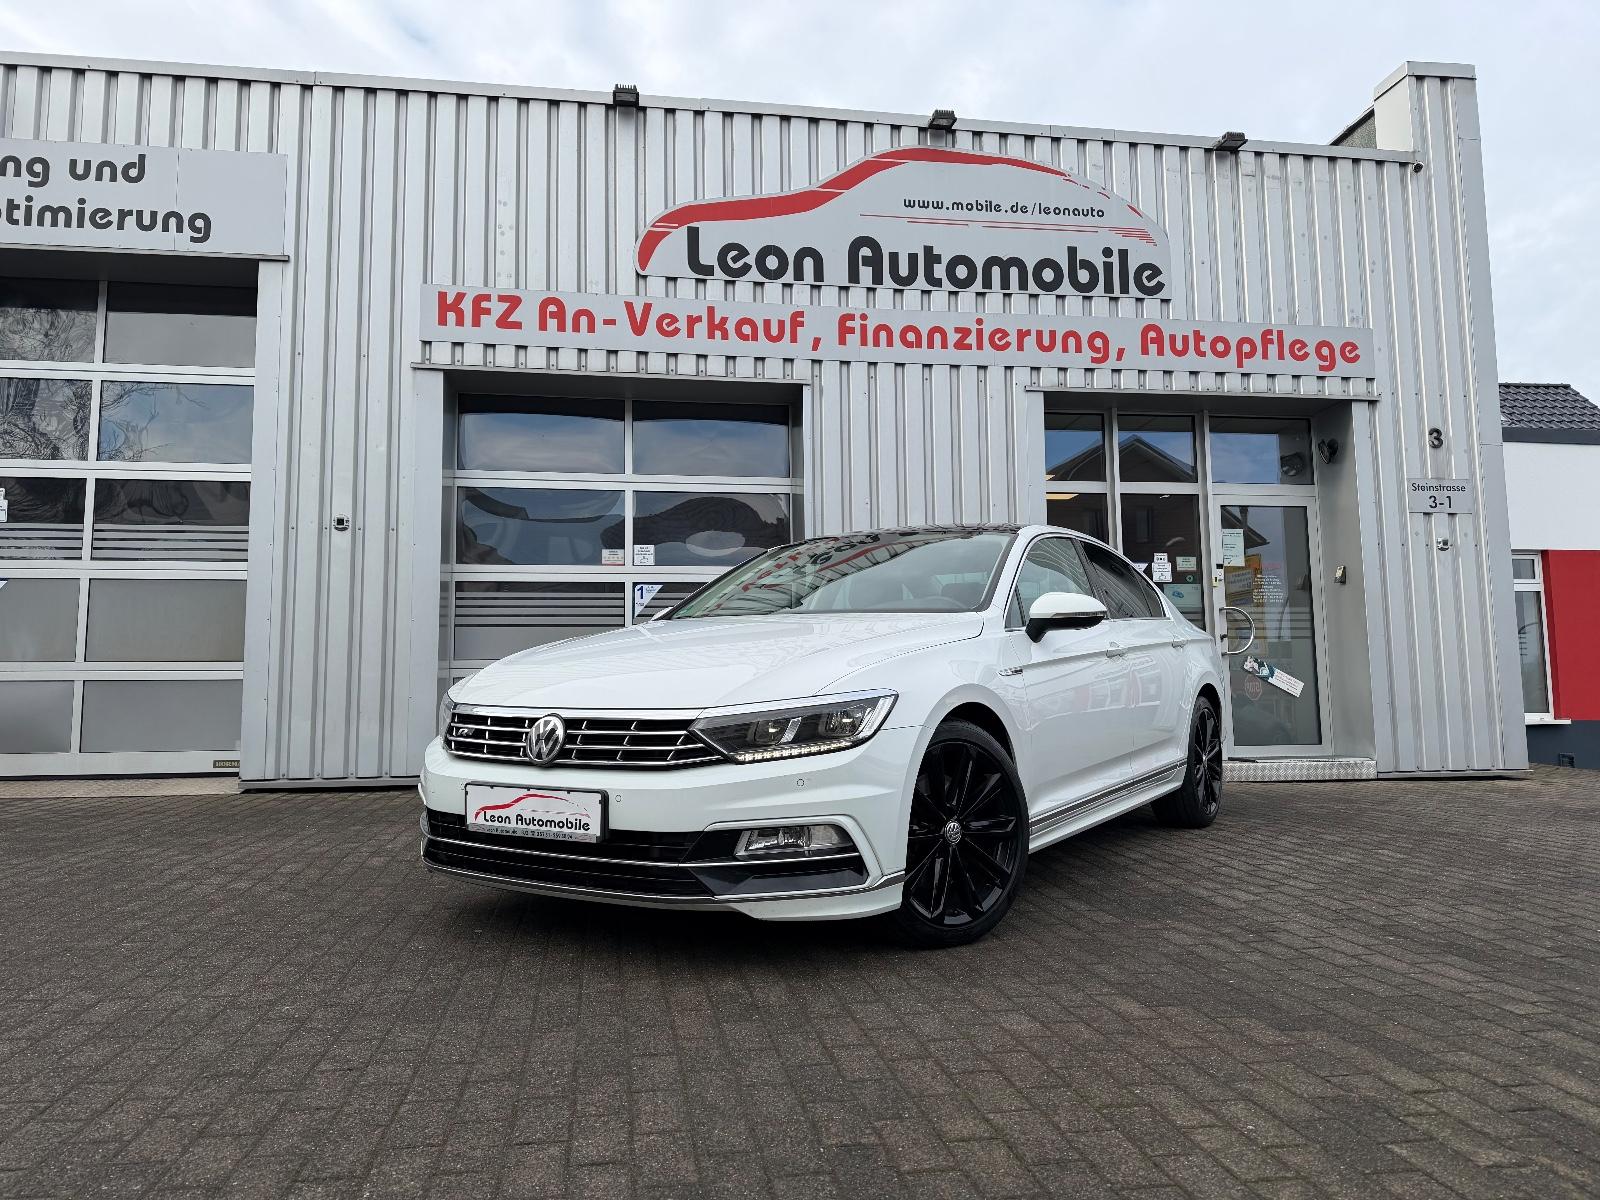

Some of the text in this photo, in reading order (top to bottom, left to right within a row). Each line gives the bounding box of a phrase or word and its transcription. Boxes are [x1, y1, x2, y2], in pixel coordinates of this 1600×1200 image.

[68, 153, 147, 184] und
[0, 194, 212, 244] timierung
[903, 198, 1105, 218] www.mobile.de/leonauto
[686, 225, 1166, 297] Leon Automobile
[538, 296, 822, 352] An-Verkauf,
[837, 313, 1125, 365] Finanzierung,
[1140, 323, 1362, 374] Autopflege
[1428, 427, 1444, 449] 3
[1411, 482, 1466, 492] Steinstrasse
[1428, 495, 1452, 509] 3-1
[483, 810, 591, 832] Leon Automobile
